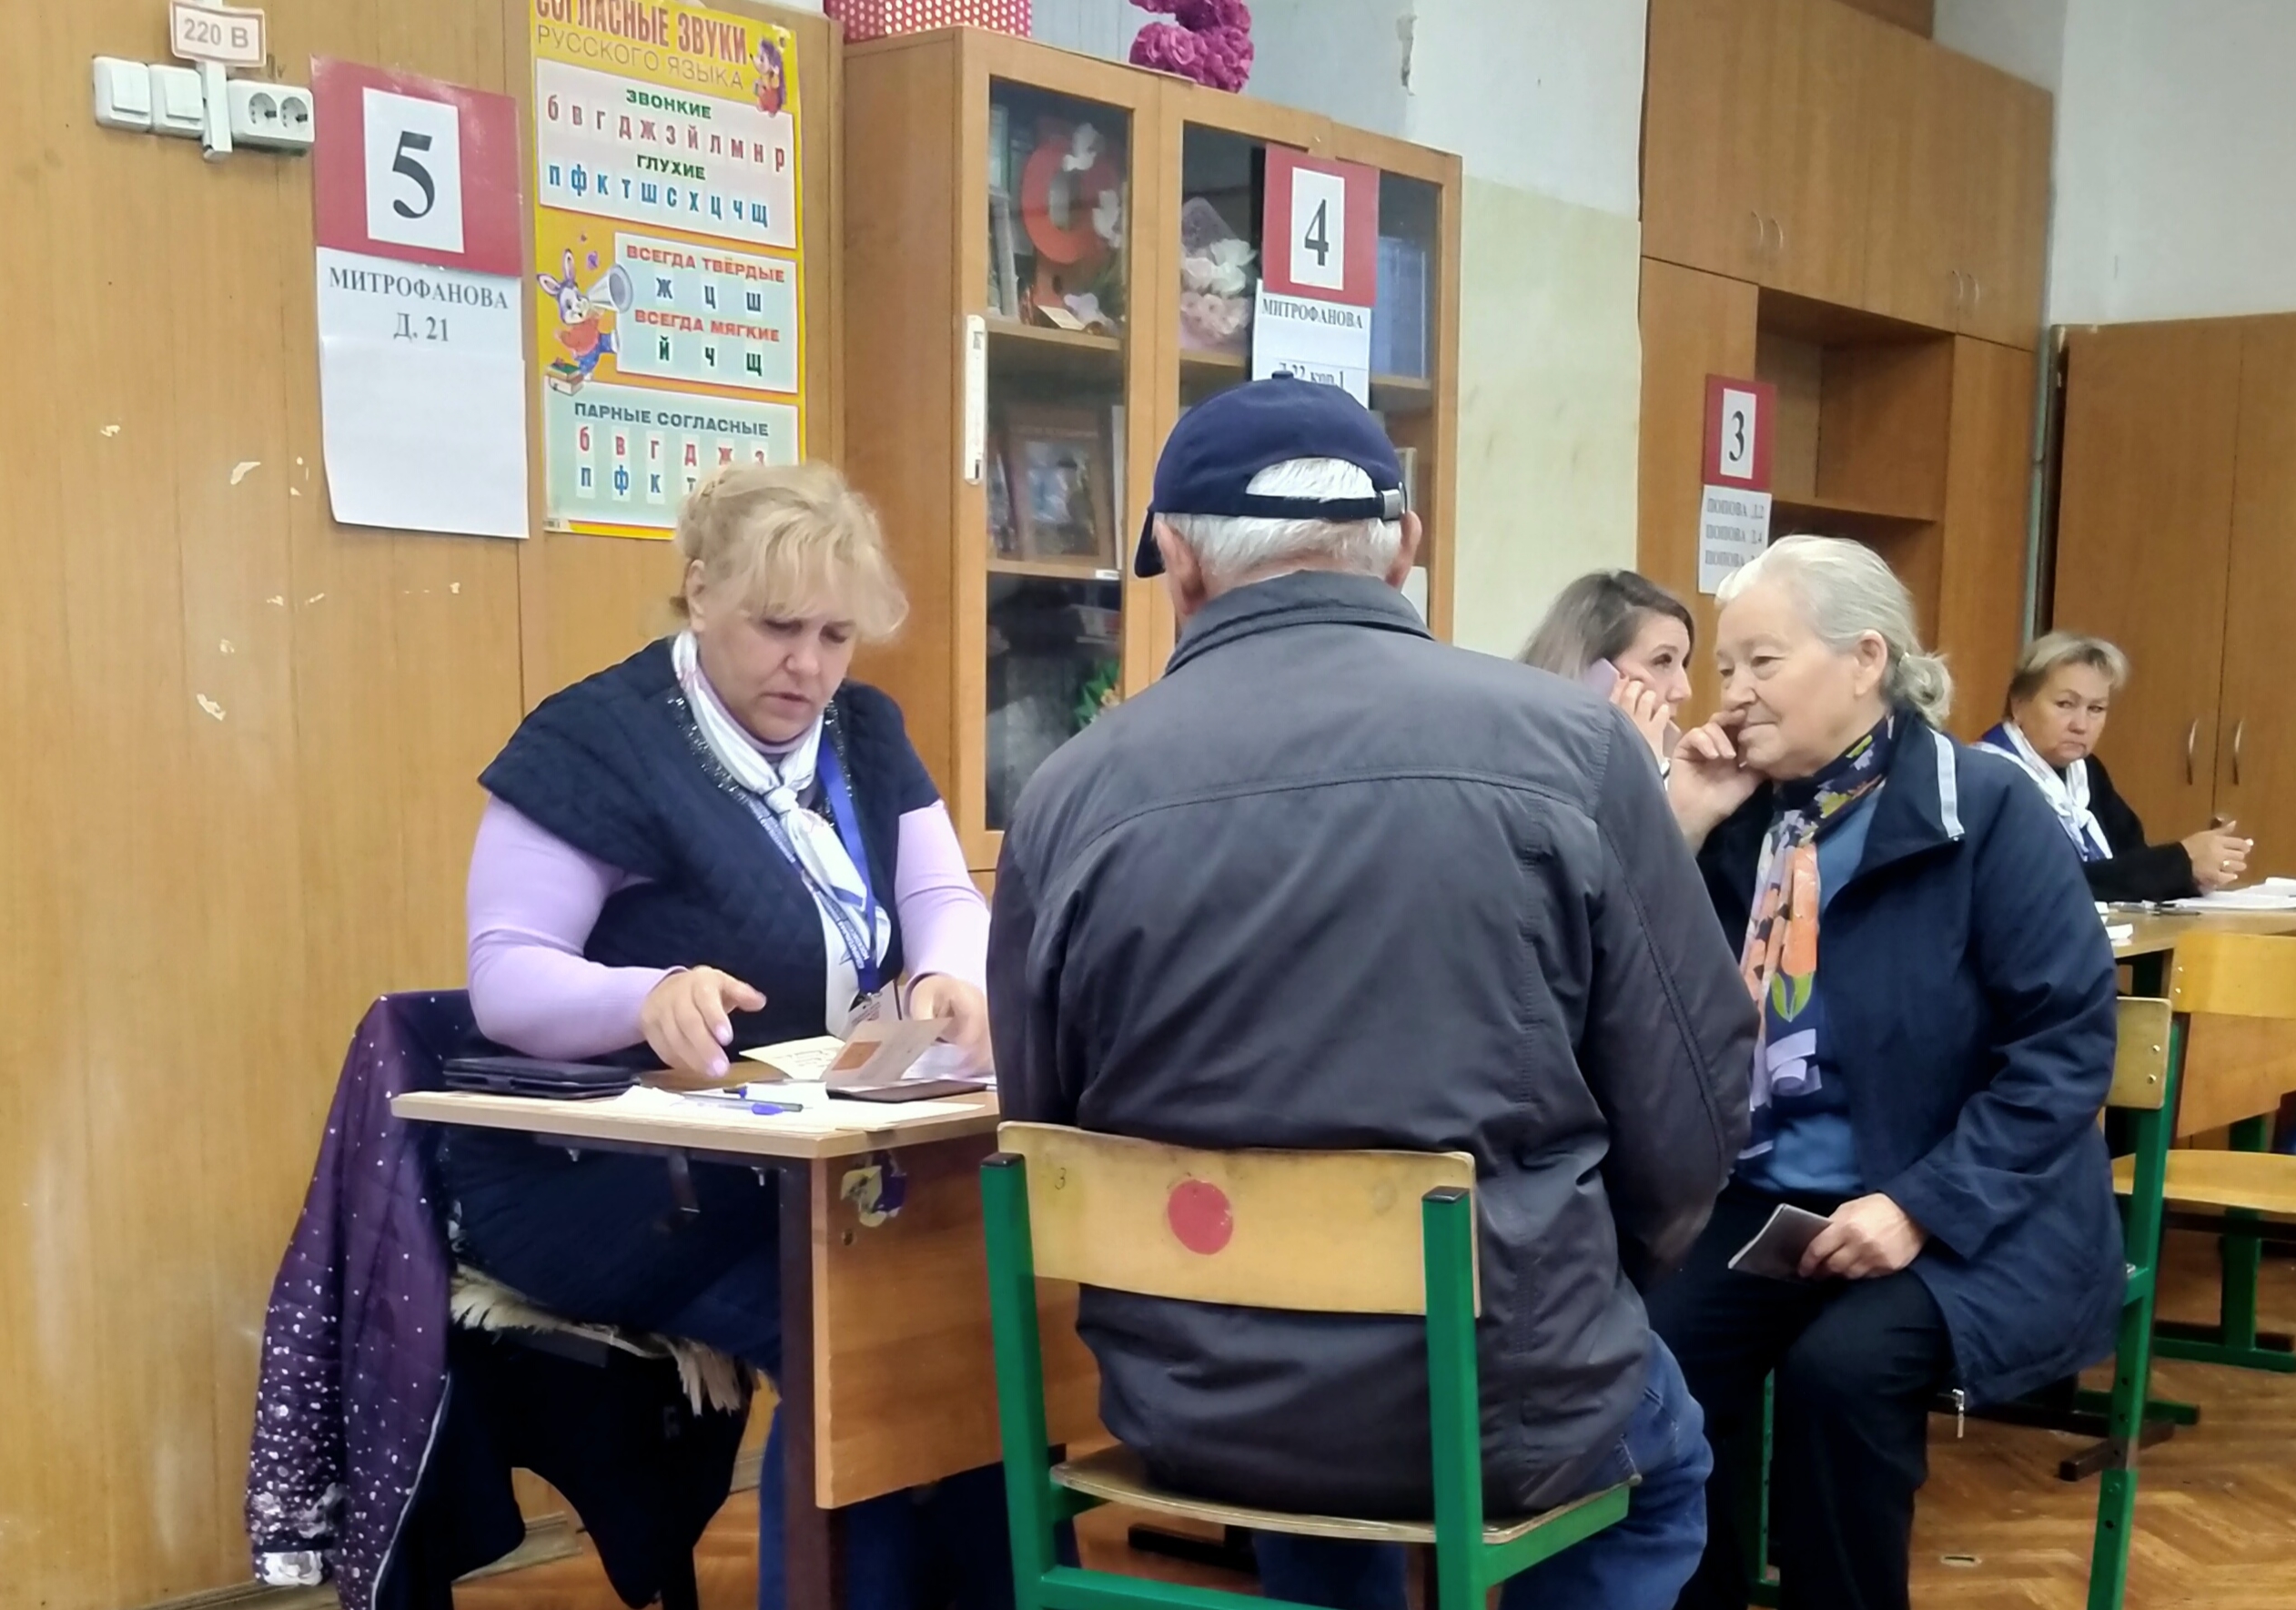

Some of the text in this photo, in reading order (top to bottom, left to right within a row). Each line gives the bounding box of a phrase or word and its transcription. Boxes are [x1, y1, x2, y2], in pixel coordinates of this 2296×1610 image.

[183, 18, 222, 46] 220
[678, 12, 746, 65] ЗВУКИ
[538, 25, 743, 89] РУССКОГО ЯЗЫКА
[626, 89, 711, 119] ЗВОНКИЕ
[392, 130, 435, 219] 5
[637, 155, 705, 180] ГЛУХИЕ
[1304, 199, 1329, 266] 4
[627, 245, 784, 282] ВСЕГДА ТВЁРДЫЕ
[329, 267, 509, 309] МИТРОФАНОВА
[425, 316, 450, 342] 21
[635, 309, 780, 342] ВСЕГДА МЯГКИЕ
[1262, 299, 1363, 329] МИТРОФАНОВА
[575, 402, 769, 437] ПАРНЫЕ СОГЛАСНЫЕ
[1728, 410, 1745, 461] 3
